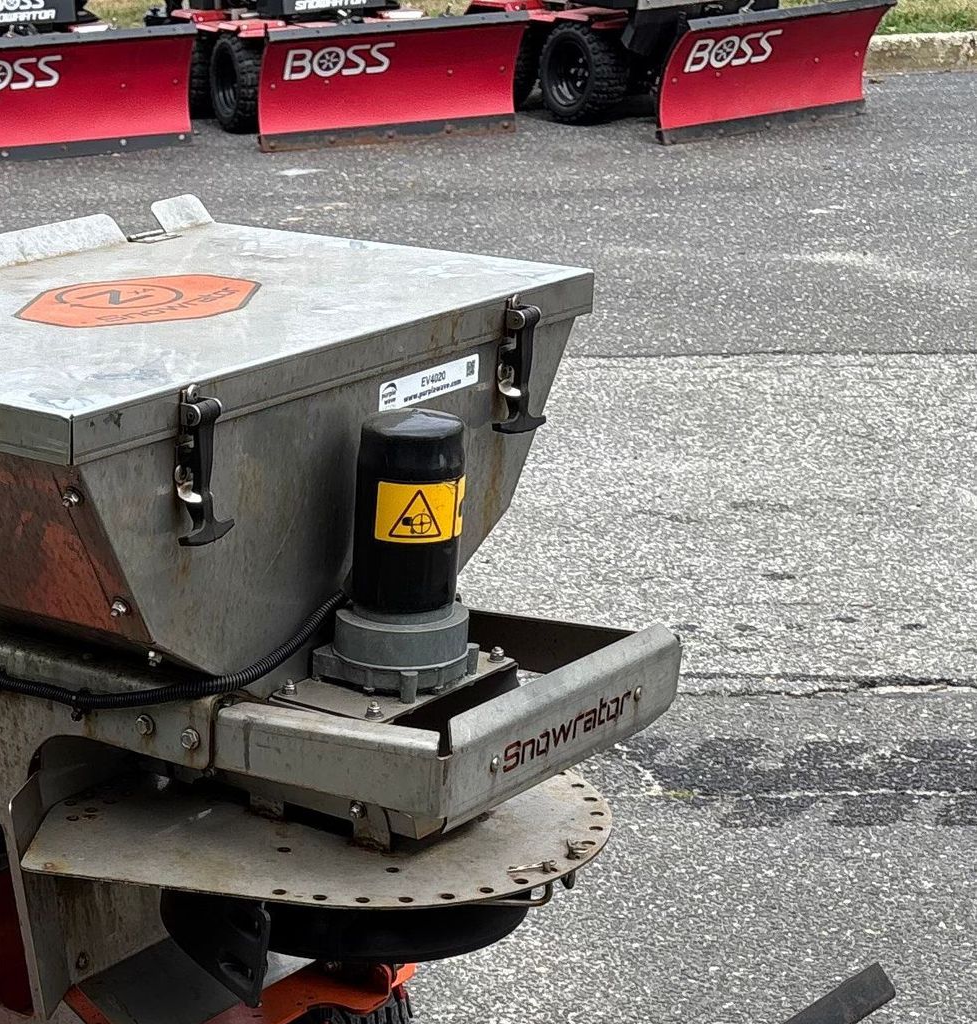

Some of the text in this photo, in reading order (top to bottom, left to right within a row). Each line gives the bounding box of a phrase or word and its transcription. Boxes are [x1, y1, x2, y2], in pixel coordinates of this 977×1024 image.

[283, 42, 396, 80] BOSS
[683, 29, 783, 73] BOSS
[403, 379, 462, 402] www.purplewave.com
[420, 370, 447, 387] EV4020
[502, 690, 632, 773] Snowrator
